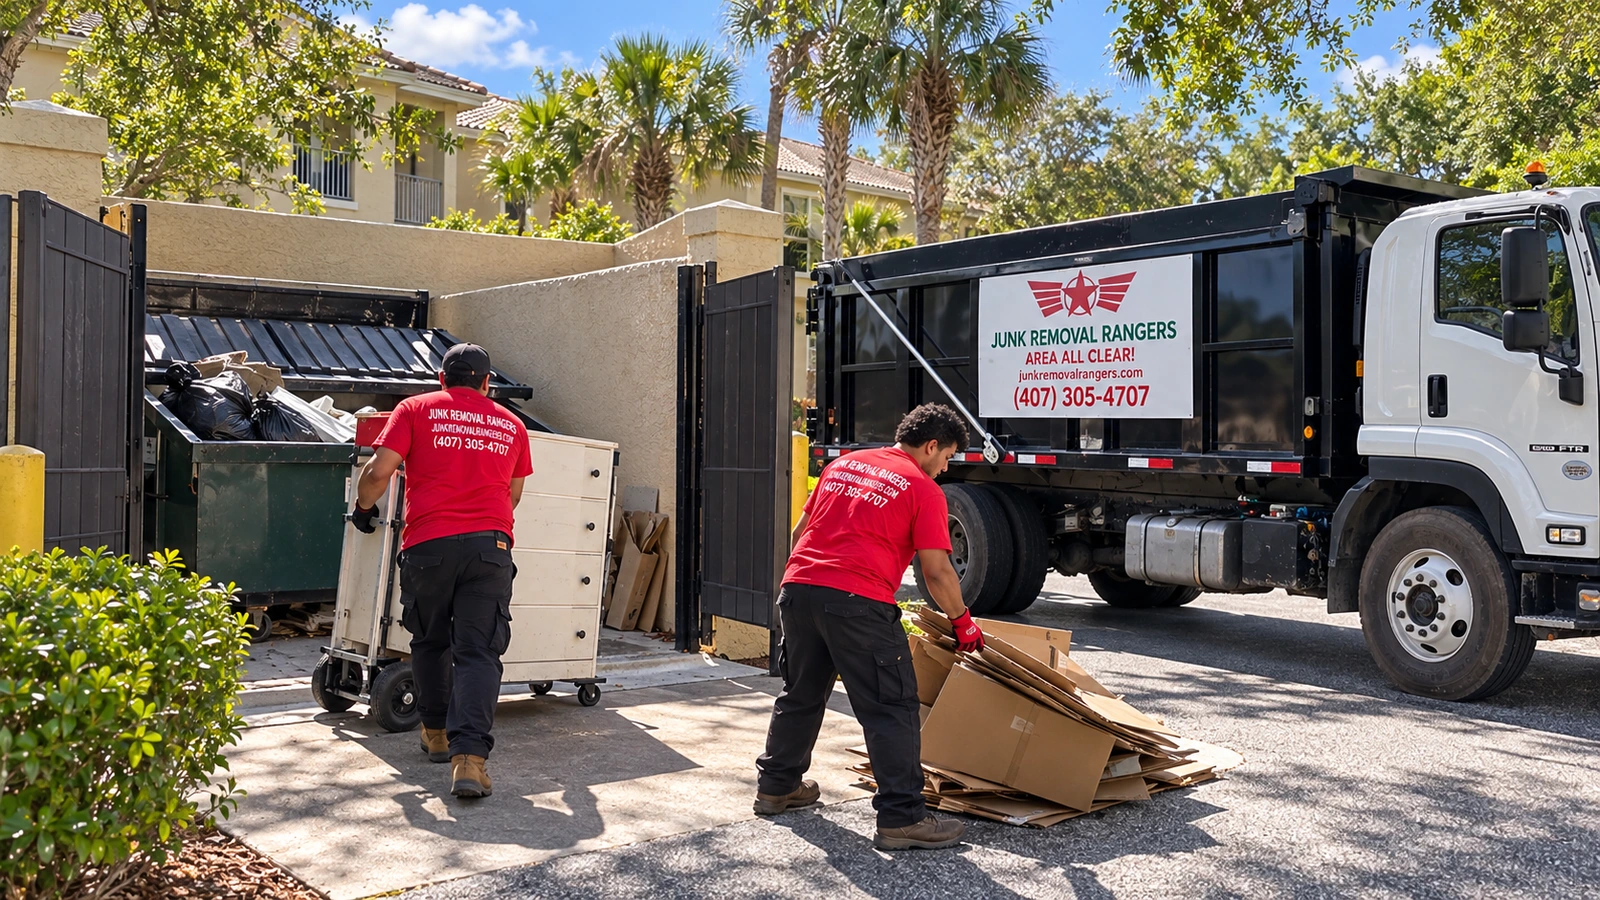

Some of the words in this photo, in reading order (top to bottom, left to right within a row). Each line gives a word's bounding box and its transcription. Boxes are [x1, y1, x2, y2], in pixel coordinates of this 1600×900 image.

[991, 331, 1026, 348] JUNK
[1030, 326, 1097, 346] REMOVAL
[1102, 320, 1177, 342] RANGERS
[1025, 351, 1058, 365] AREA
[1061, 350, 1084, 364] ALL
[1088, 347, 1135, 362] CLEAR!
[1018, 368, 1143, 383] junkremovalrangers.com
[1014, 386, 1057, 410] (407)
[1062, 385, 1150, 407] 305-4707
[428, 408, 449, 420] JUNK
[450, 410, 485, 424] REMOVAL
[433, 435, 462, 450] (407)
[465, 438, 509, 456] 305-4707
[822, 480, 846, 496] (407)
[844, 485, 888, 508] 305-4707
